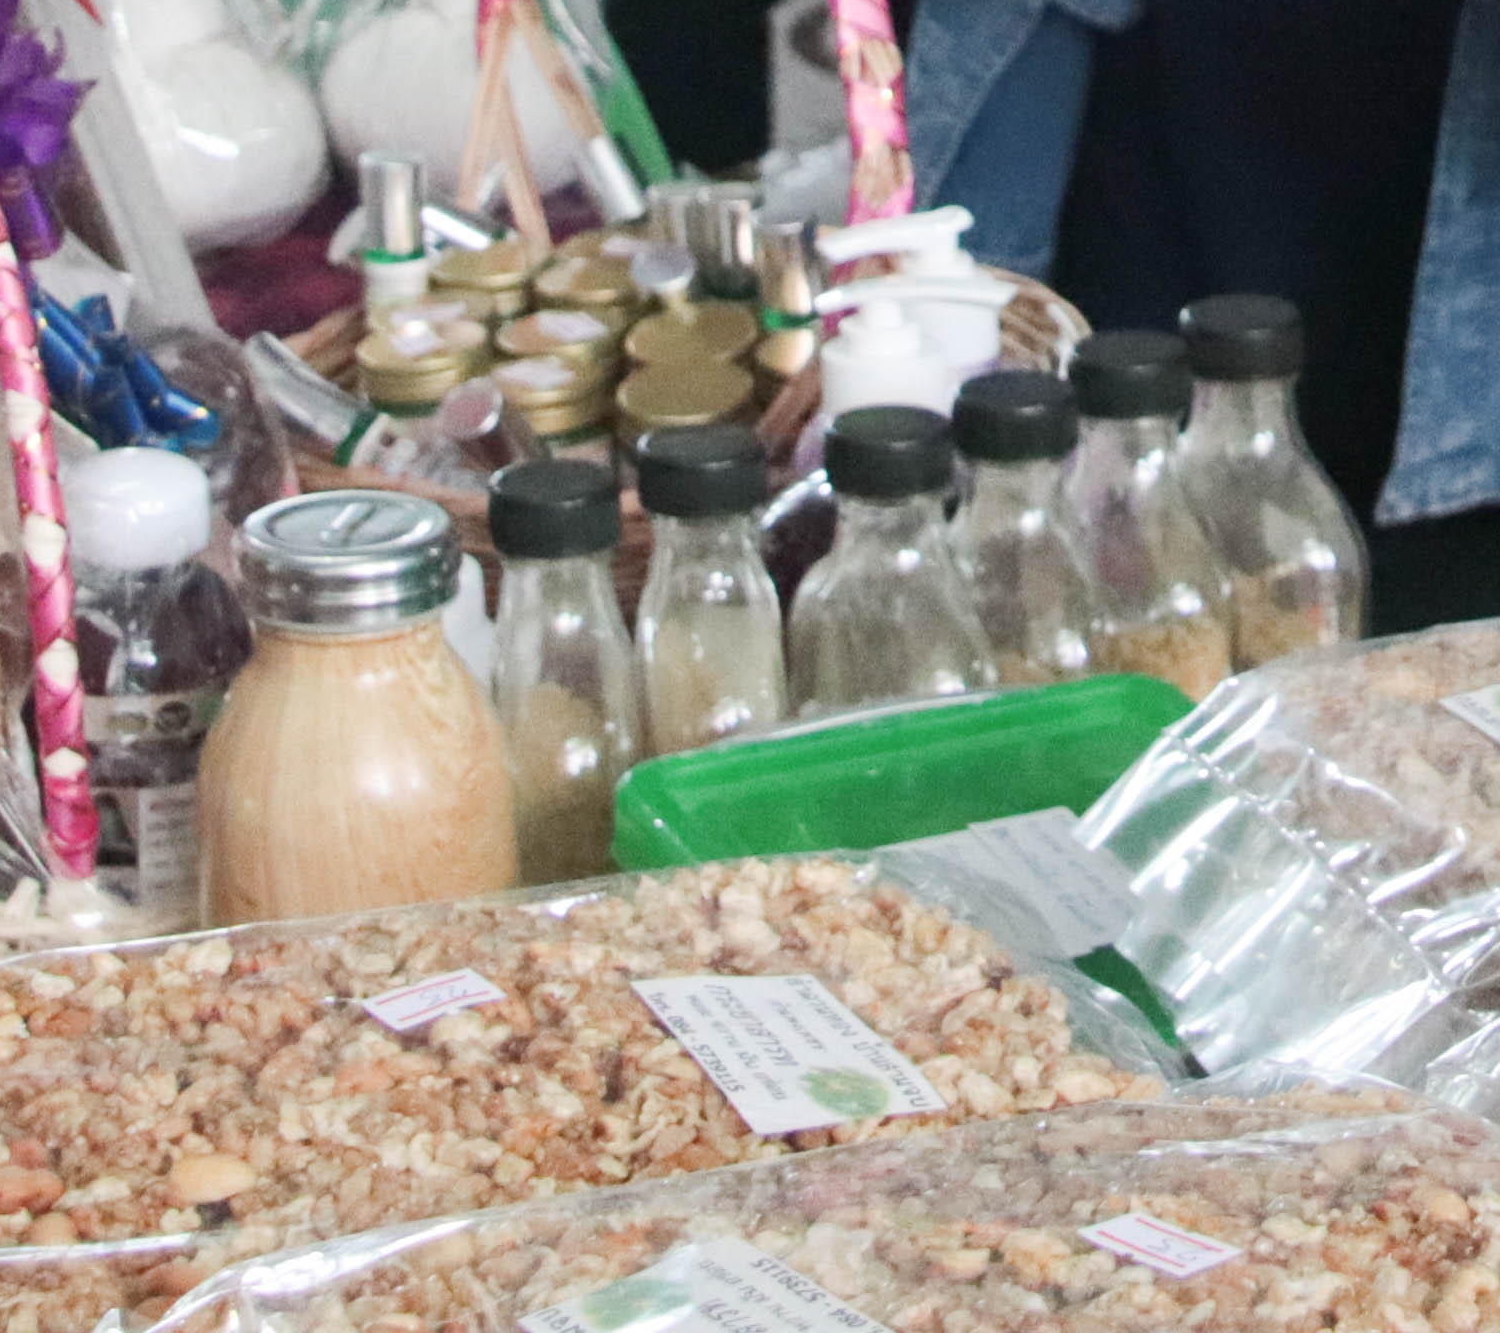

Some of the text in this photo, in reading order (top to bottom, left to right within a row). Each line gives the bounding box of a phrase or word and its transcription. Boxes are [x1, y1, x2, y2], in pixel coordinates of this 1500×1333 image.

[668, 1016, 694, 1034] 084
[692, 1044, 746, 1092] 5739115
[706, 985, 801, 1067] กระยาสารท
[748, 1258, 828, 1304] 5739115
[828, 1307, 869, 1329] 084
